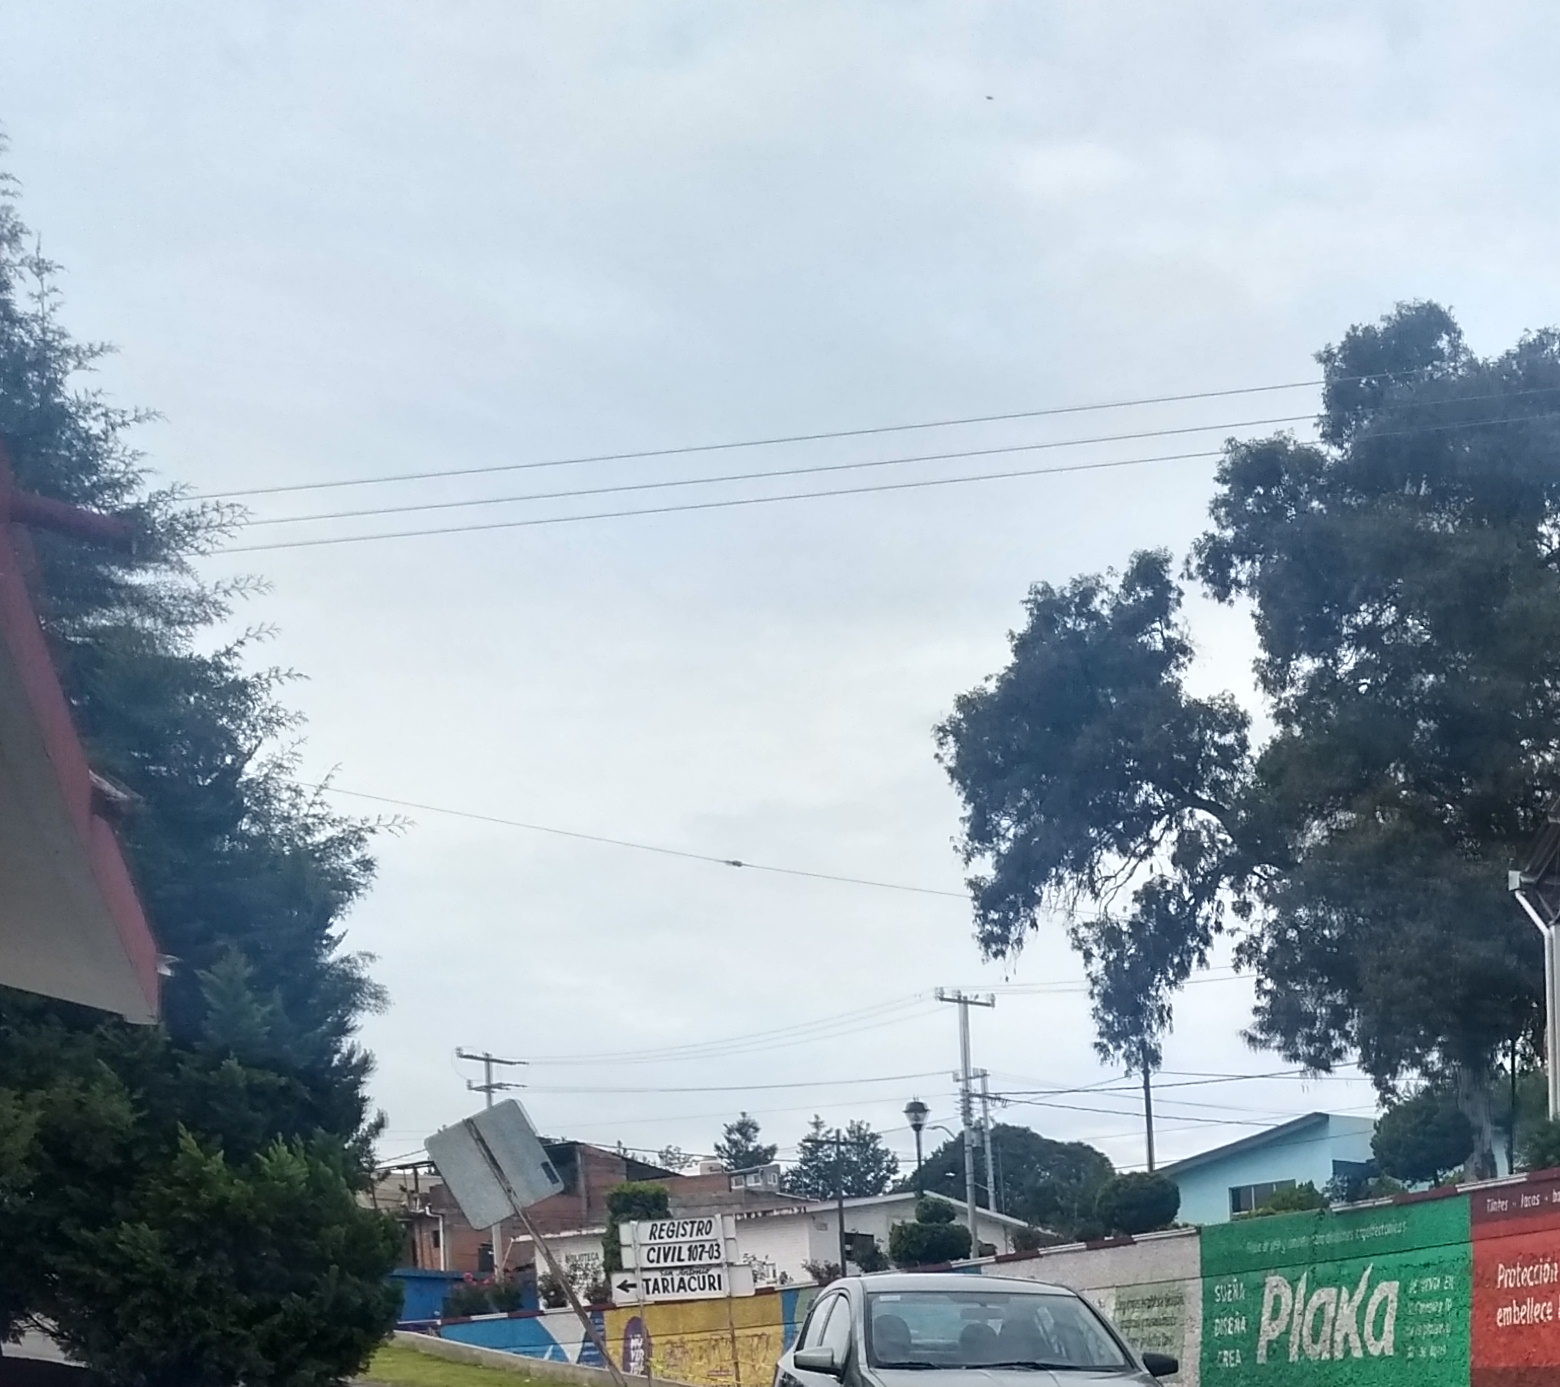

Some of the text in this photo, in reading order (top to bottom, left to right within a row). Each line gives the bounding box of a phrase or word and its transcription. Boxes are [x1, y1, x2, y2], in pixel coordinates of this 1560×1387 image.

[1486, 1198, 1508, 1213] Tintes
[1520, 1193, 1541, 1209] lacas
[648, 1219, 713, 1241] REGISTRO
[646, 1242, 721, 1264] CIVIL 107-03
[641, 1273, 723, 1296] TARIACURI
[1256, 1262, 1401, 1365] Plaka
[1496, 1296, 1553, 1328] embellece
[1217, 1349, 1243, 1369] CREA
